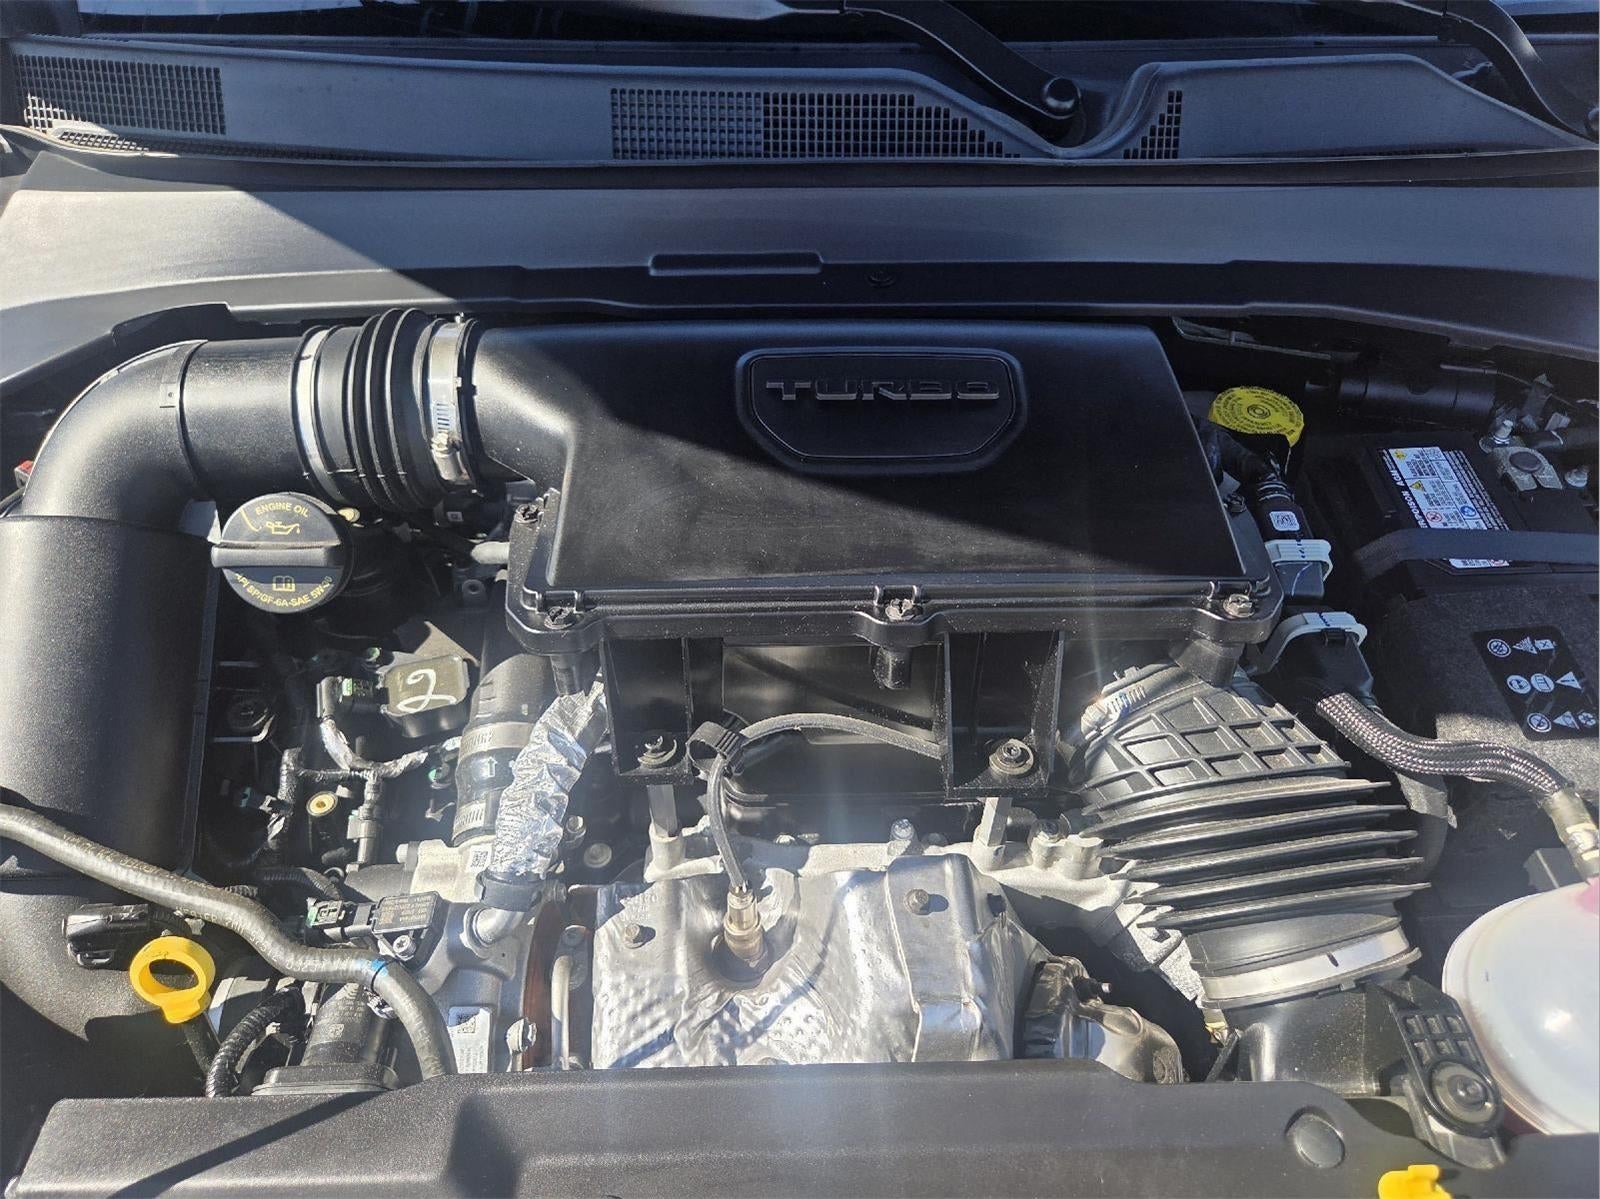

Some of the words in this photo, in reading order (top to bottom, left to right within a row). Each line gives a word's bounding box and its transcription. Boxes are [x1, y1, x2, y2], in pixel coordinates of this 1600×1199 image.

[766, 380, 999, 400] TURBO
[255, 502, 292, 515] ENGINE
[293, 504, 310, 518] OIL
[396, 668, 457, 714] 2
